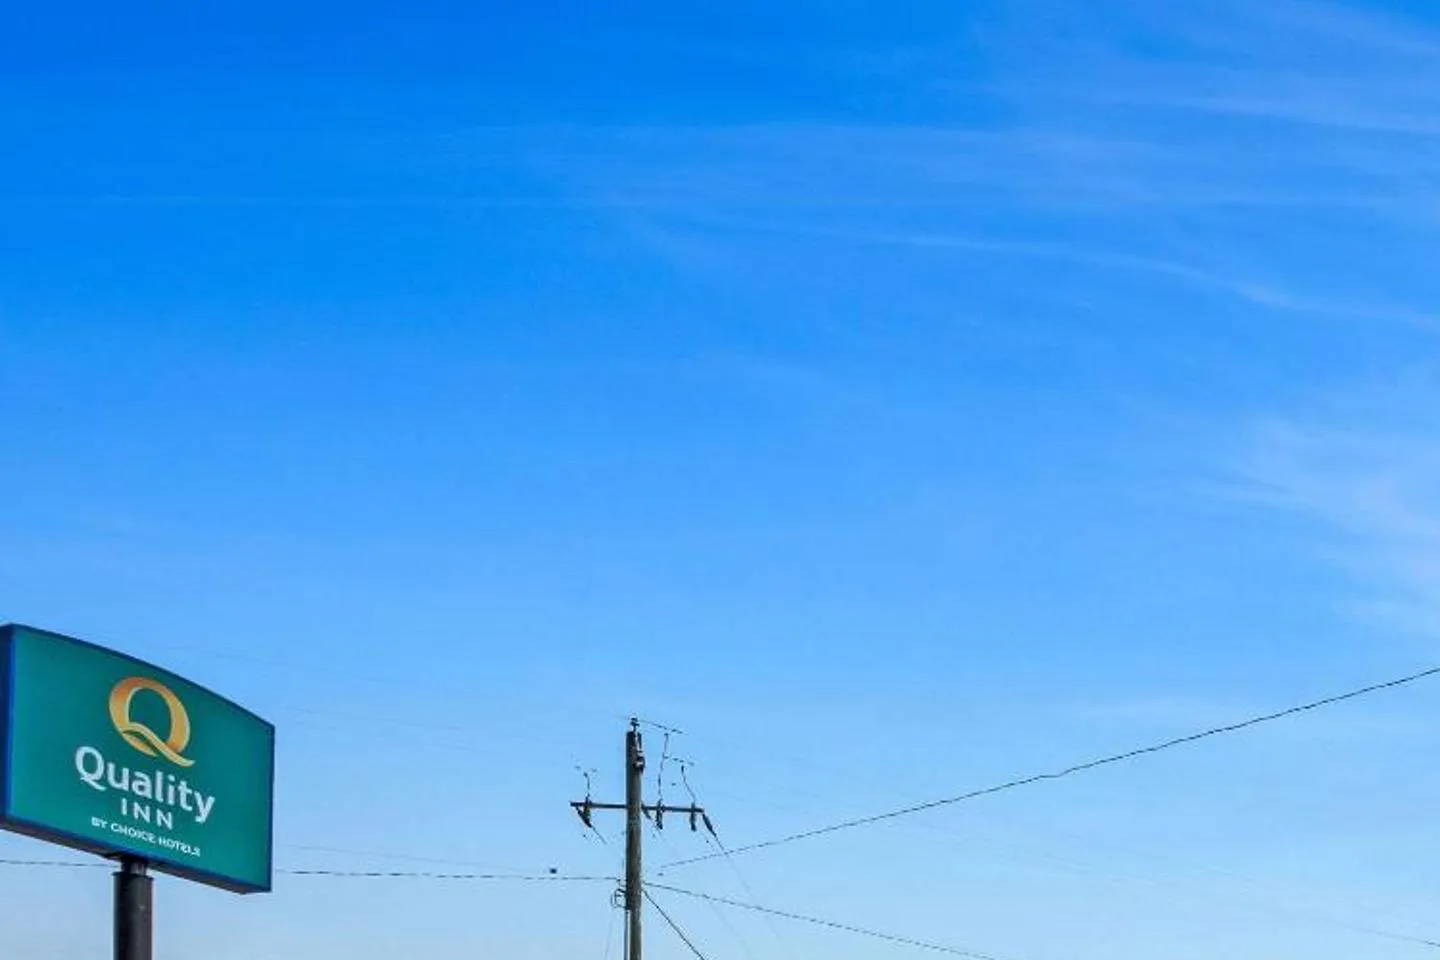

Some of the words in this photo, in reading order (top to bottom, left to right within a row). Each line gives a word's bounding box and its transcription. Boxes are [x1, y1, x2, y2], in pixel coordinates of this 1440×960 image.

[109, 676, 196, 767] Q
[75, 746, 215, 823] Quality
[121, 798, 173, 830] INN
[91, 816, 108, 829] BY
[110, 823, 156, 844] CHOICE
[157, 836, 201, 857] HOTELS
